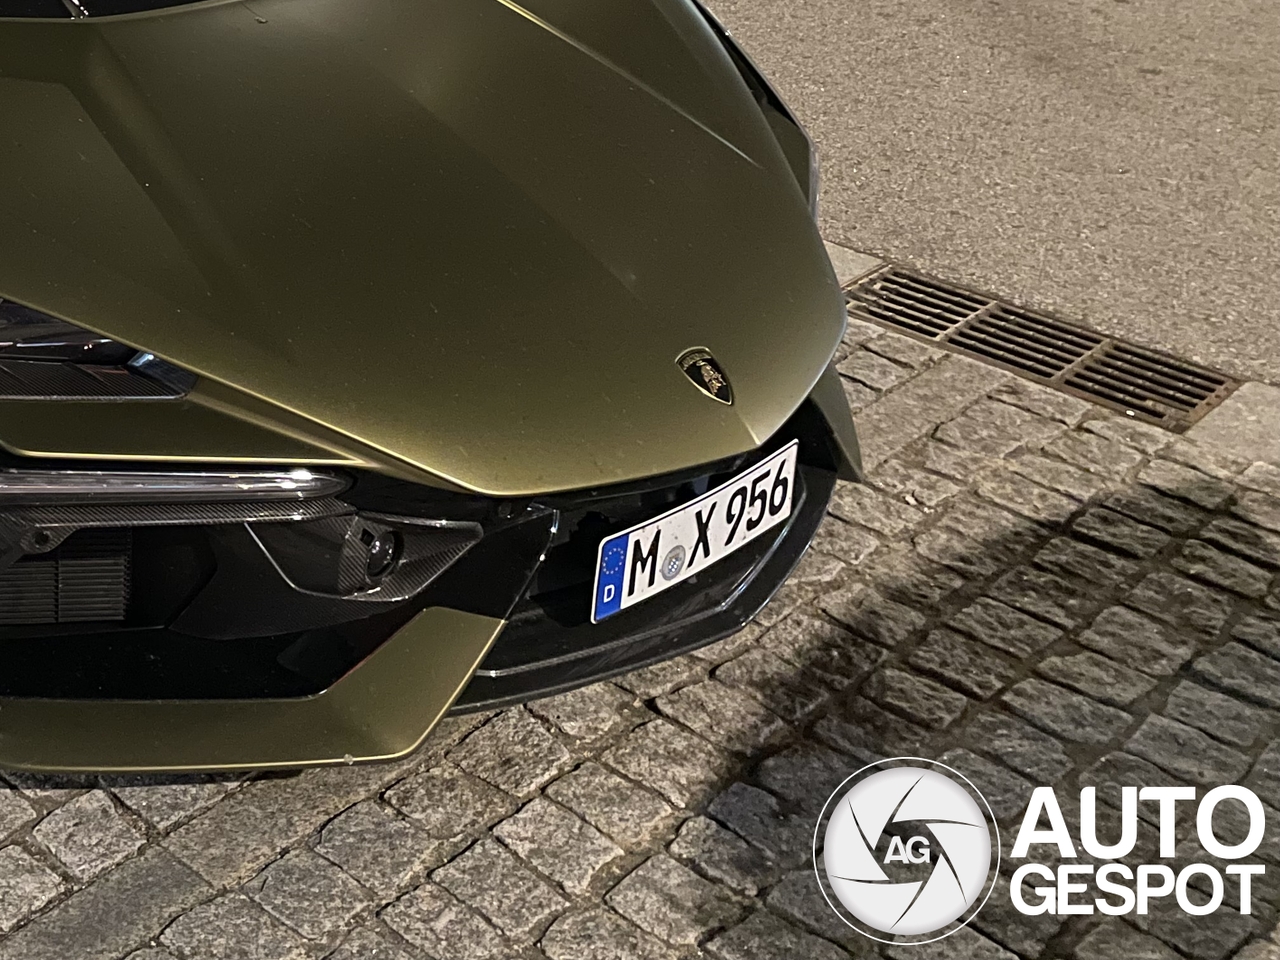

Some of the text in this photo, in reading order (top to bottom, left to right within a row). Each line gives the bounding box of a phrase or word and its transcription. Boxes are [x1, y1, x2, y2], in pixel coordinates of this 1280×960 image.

[627, 458, 789, 597] M X 956
[603, 584, 616, 603] D
